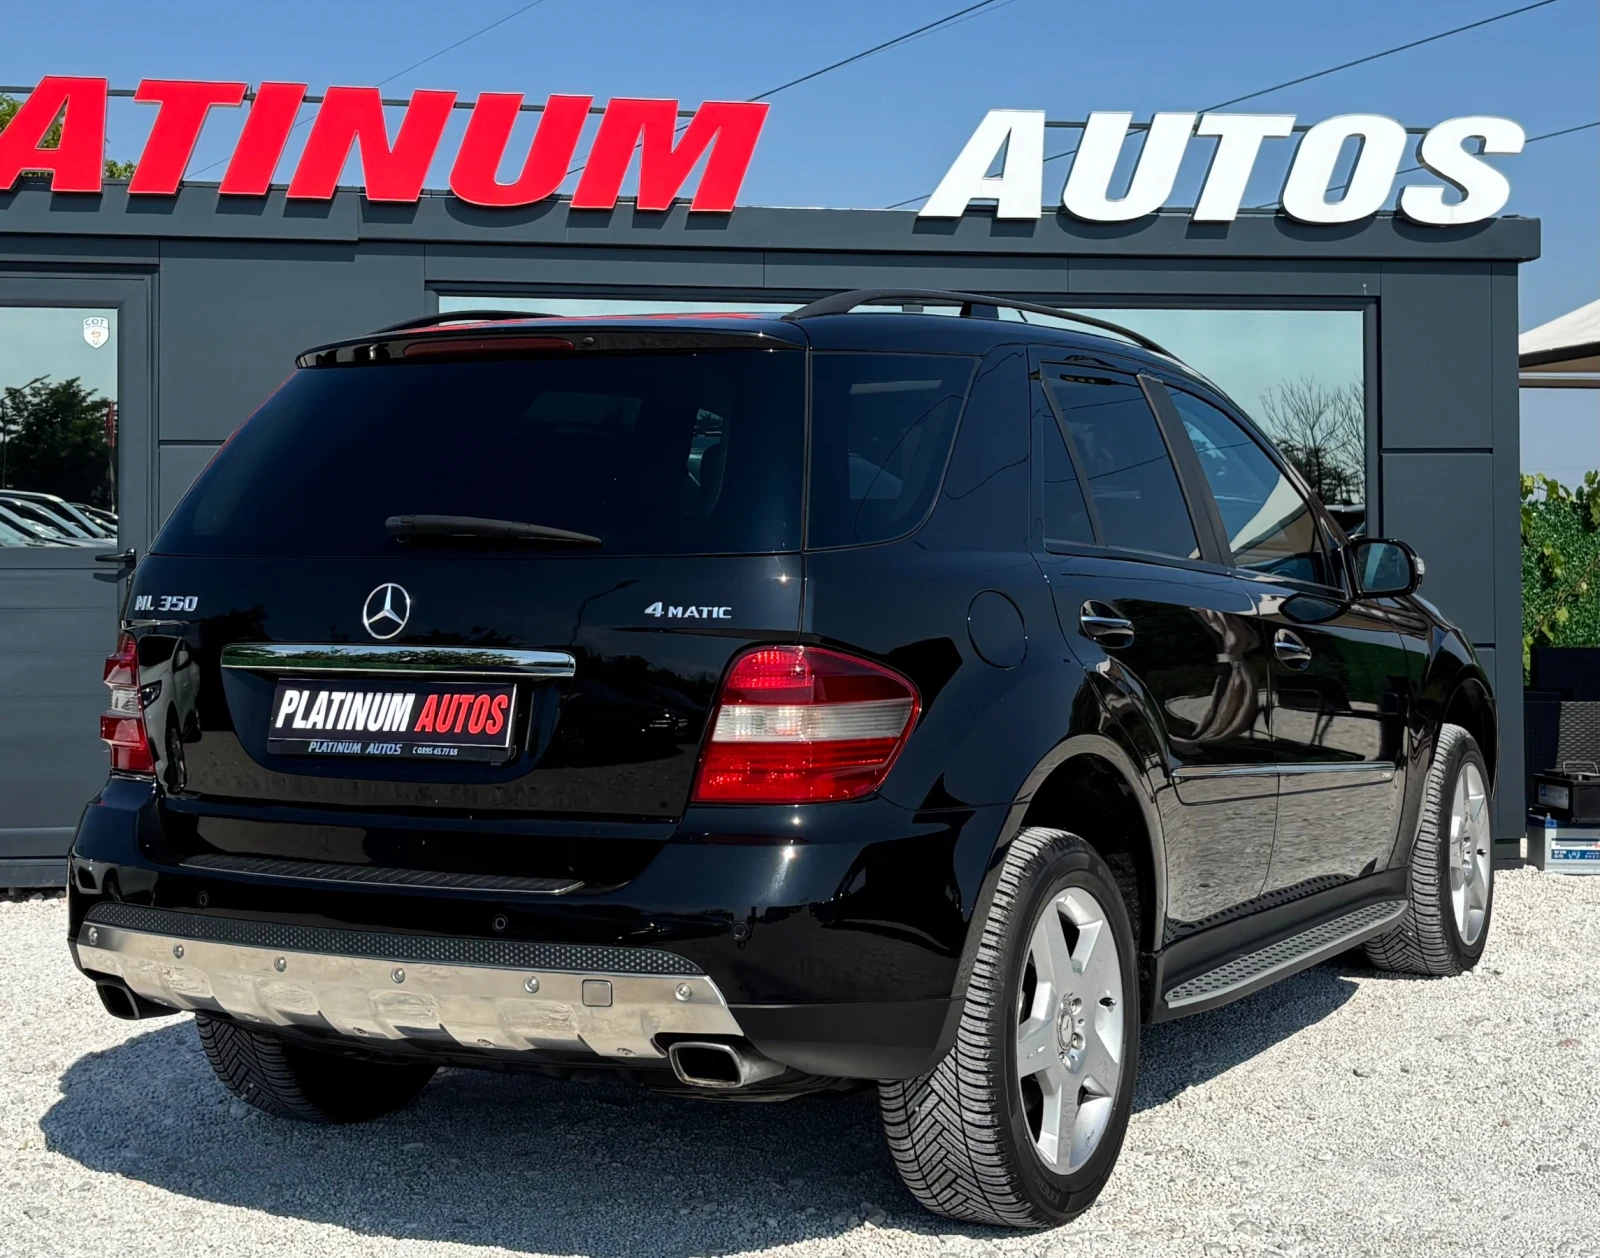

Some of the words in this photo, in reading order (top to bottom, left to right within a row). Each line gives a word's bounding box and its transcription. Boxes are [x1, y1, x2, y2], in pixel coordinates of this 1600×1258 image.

[0, 75, 770, 213] ATINUM
[918, 108, 1527, 226] AUTOS
[157, 595, 199, 612] 350
[275, 689, 416, 732] PLATINUM
[414, 693, 509, 735] AUTOS
[308, 741, 362, 754] PLATINUM
[365, 742, 403, 755] AUTOS
